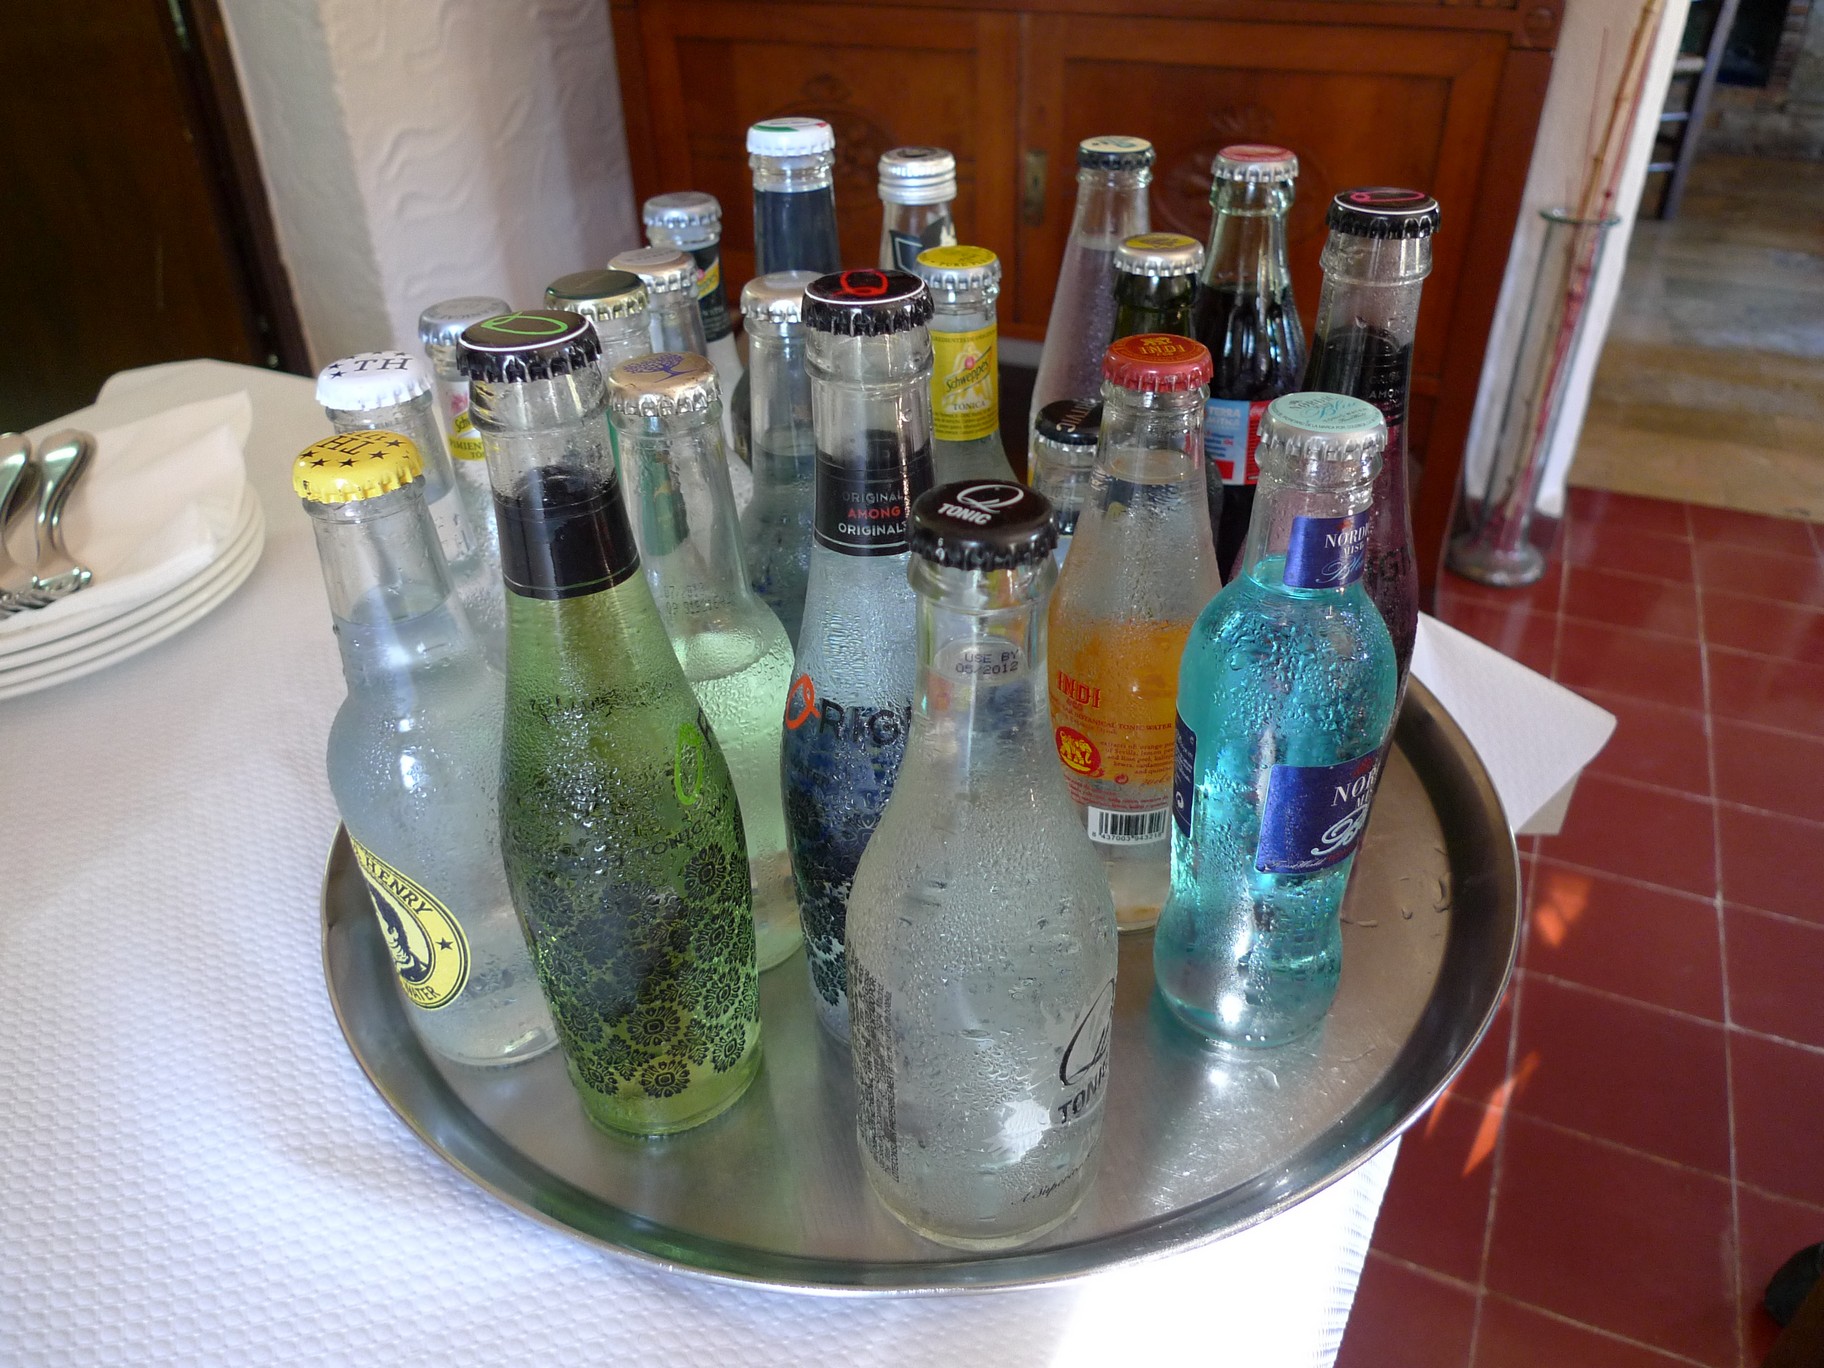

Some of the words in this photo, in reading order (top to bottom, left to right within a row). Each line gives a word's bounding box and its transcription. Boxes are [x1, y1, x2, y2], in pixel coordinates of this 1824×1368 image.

[1140, 345, 1185, 354] INDI
[354, 358, 413, 372] TH
[945, 361, 989, 393] Schweppes
[847, 505, 902, 520] AMONG
[937, 503, 992, 526] TONIC
[964, 653, 993, 664] USE
[1001, 648, 1020, 662] BY
[955, 661, 1020, 676] 05/2012
[1057, 669, 1101, 709] INDI
[1118, 723, 1144, 731] TONIC
[1145, 722, 1173, 732] WATER
[365, 855, 434, 915] HENRY
